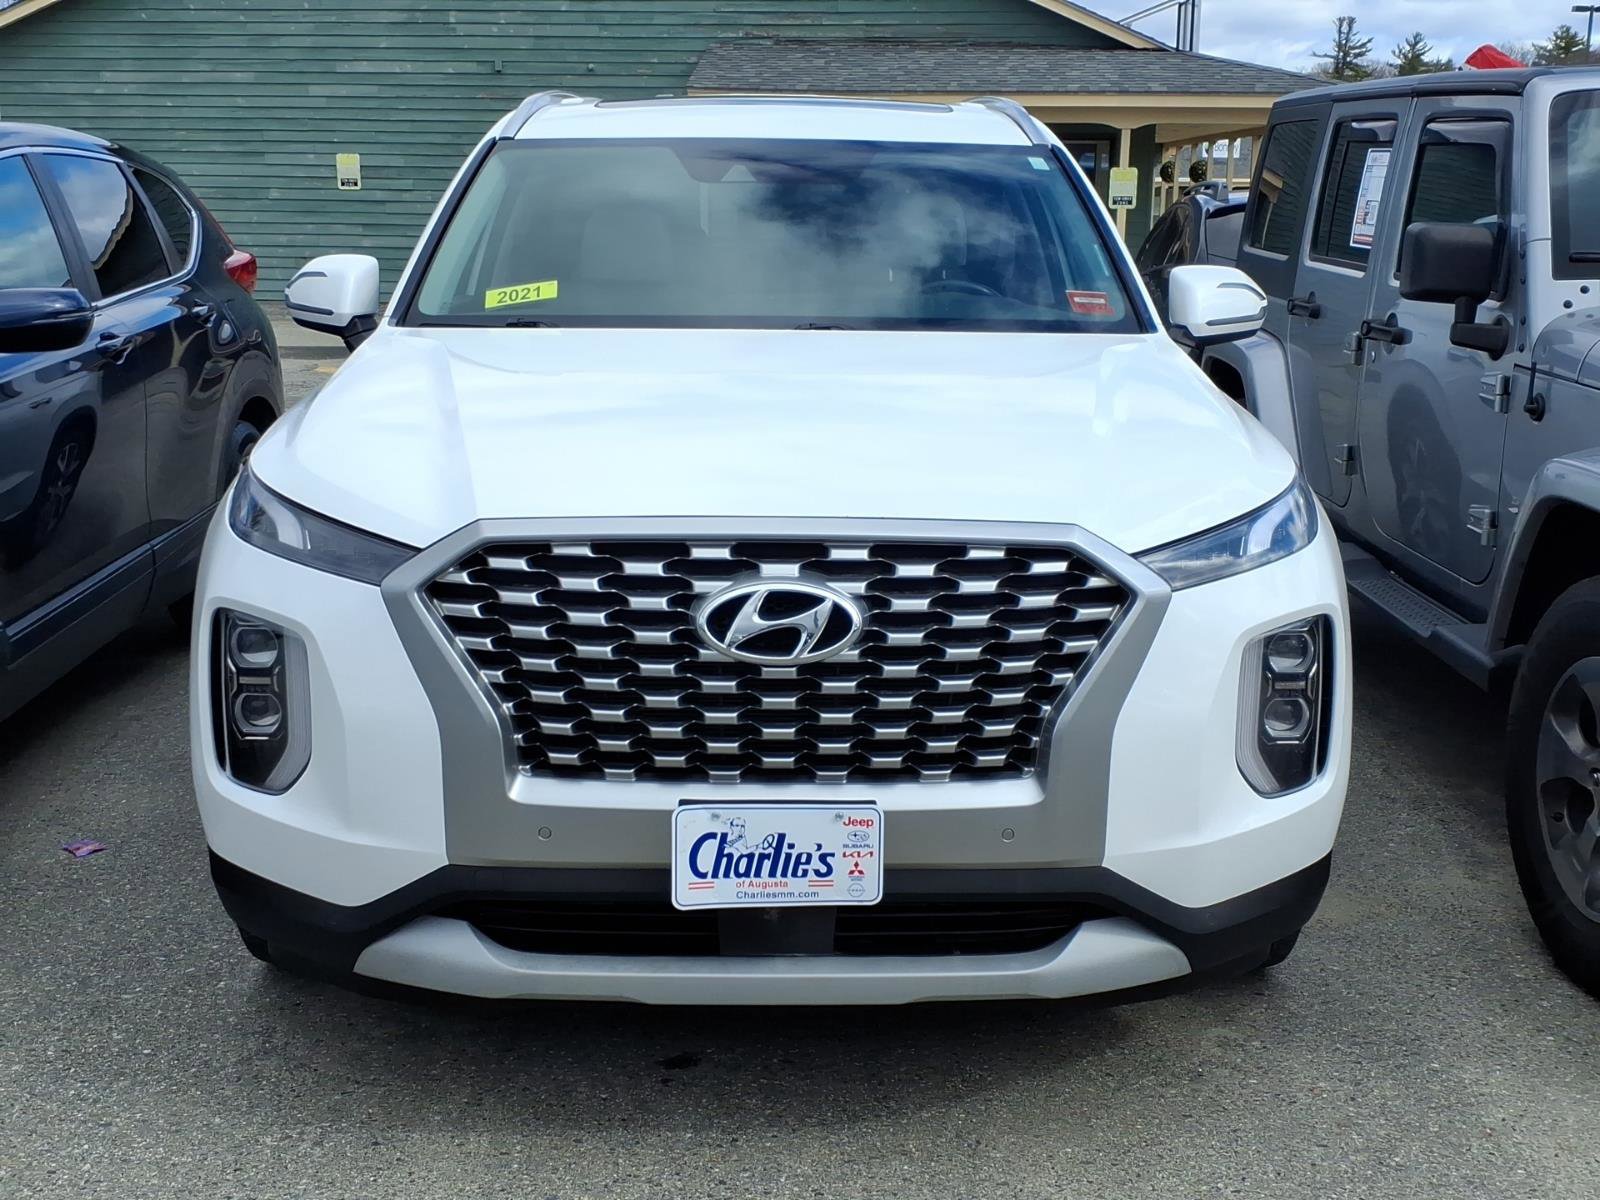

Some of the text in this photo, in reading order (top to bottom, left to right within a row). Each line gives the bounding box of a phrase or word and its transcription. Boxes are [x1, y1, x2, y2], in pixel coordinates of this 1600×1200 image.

[496, 285, 541, 304] 2021
[843, 816, 874, 828] Jeep
[688, 832, 836, 879] Charlie's
[735, 880, 789, 890] of Augusta
[735, 890, 820, 899] Charliesmm.com
